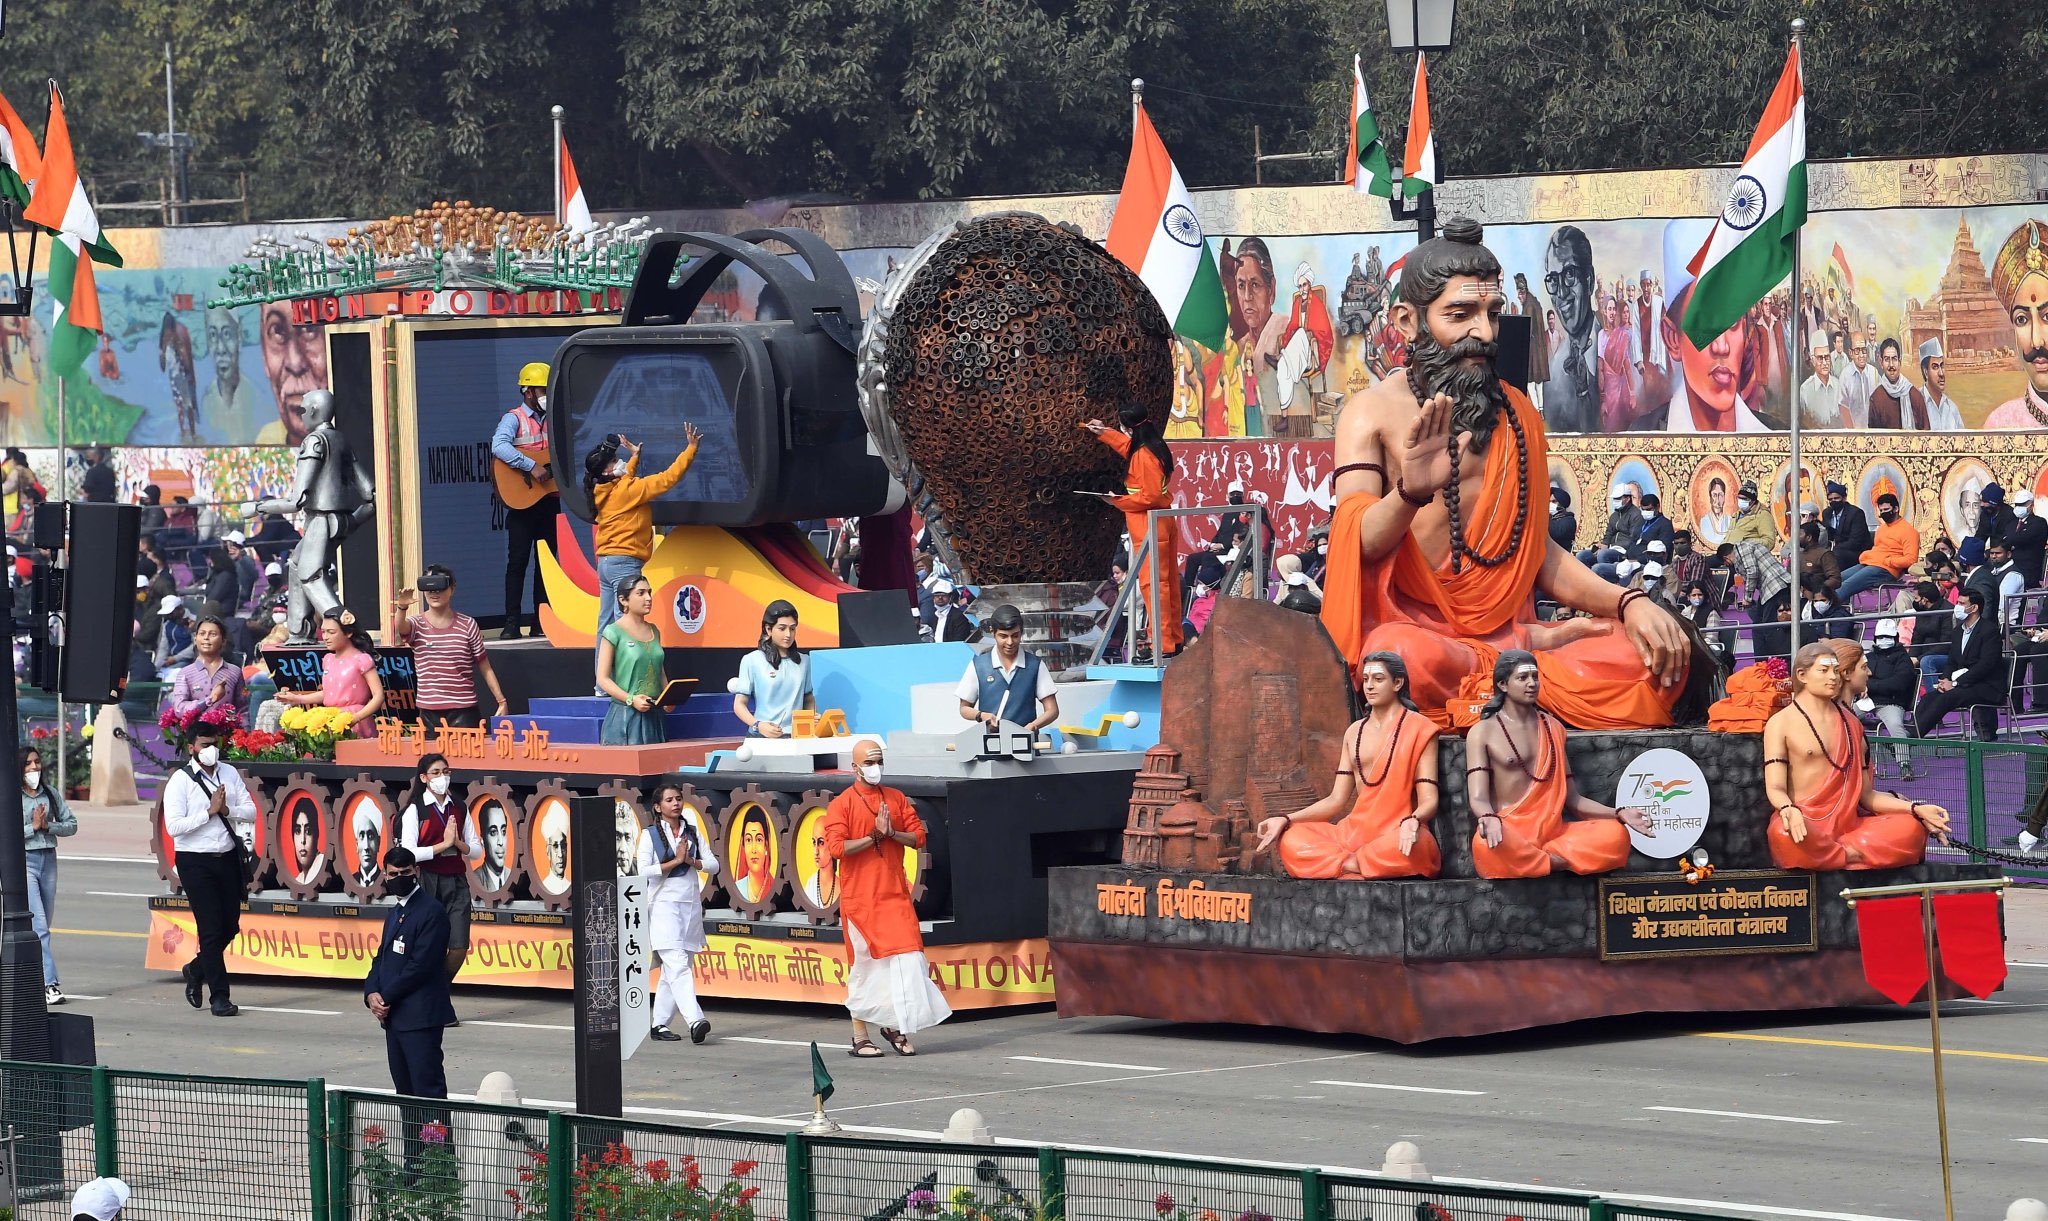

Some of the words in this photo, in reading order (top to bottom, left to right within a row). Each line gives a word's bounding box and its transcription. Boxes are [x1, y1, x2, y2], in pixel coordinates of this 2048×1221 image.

[428, 444, 476, 485] NATIONAL
[409, 717, 427, 756] से
[434, 717, 487, 758] मेटावर्स
[494, 719, 515, 760] की
[1661, 807, 1671, 816] का
[1664, 814, 1703, 832] महोत्सव
[1096, 879, 1147, 917] नालंदा
[1156, 878, 1252, 924] विश्वविद्यालय
[1608, 892, 1645, 915] शिक्षा
[1645, 890, 1698, 913] मंत्रालय
[1698, 888, 1717, 911] एवं
[1718, 886, 1764, 910] कौशल
[1764, 885, 1808, 909] विकास
[479, 911, 495, 921] Bhabha
[1632, 916, 1659, 939] और
[1659, 914, 1735, 938] उद्यमशीलता
[1735, 912, 1789, 936] मंत्रालय
[318, 931, 380, 961] EDUC
[790, 928, 815, 938] Aryabhatta
[734, 943, 779, 983] शिक्षा
[784, 946, 825, 986] नीति
[929, 951, 1054, 992] ATIONA
